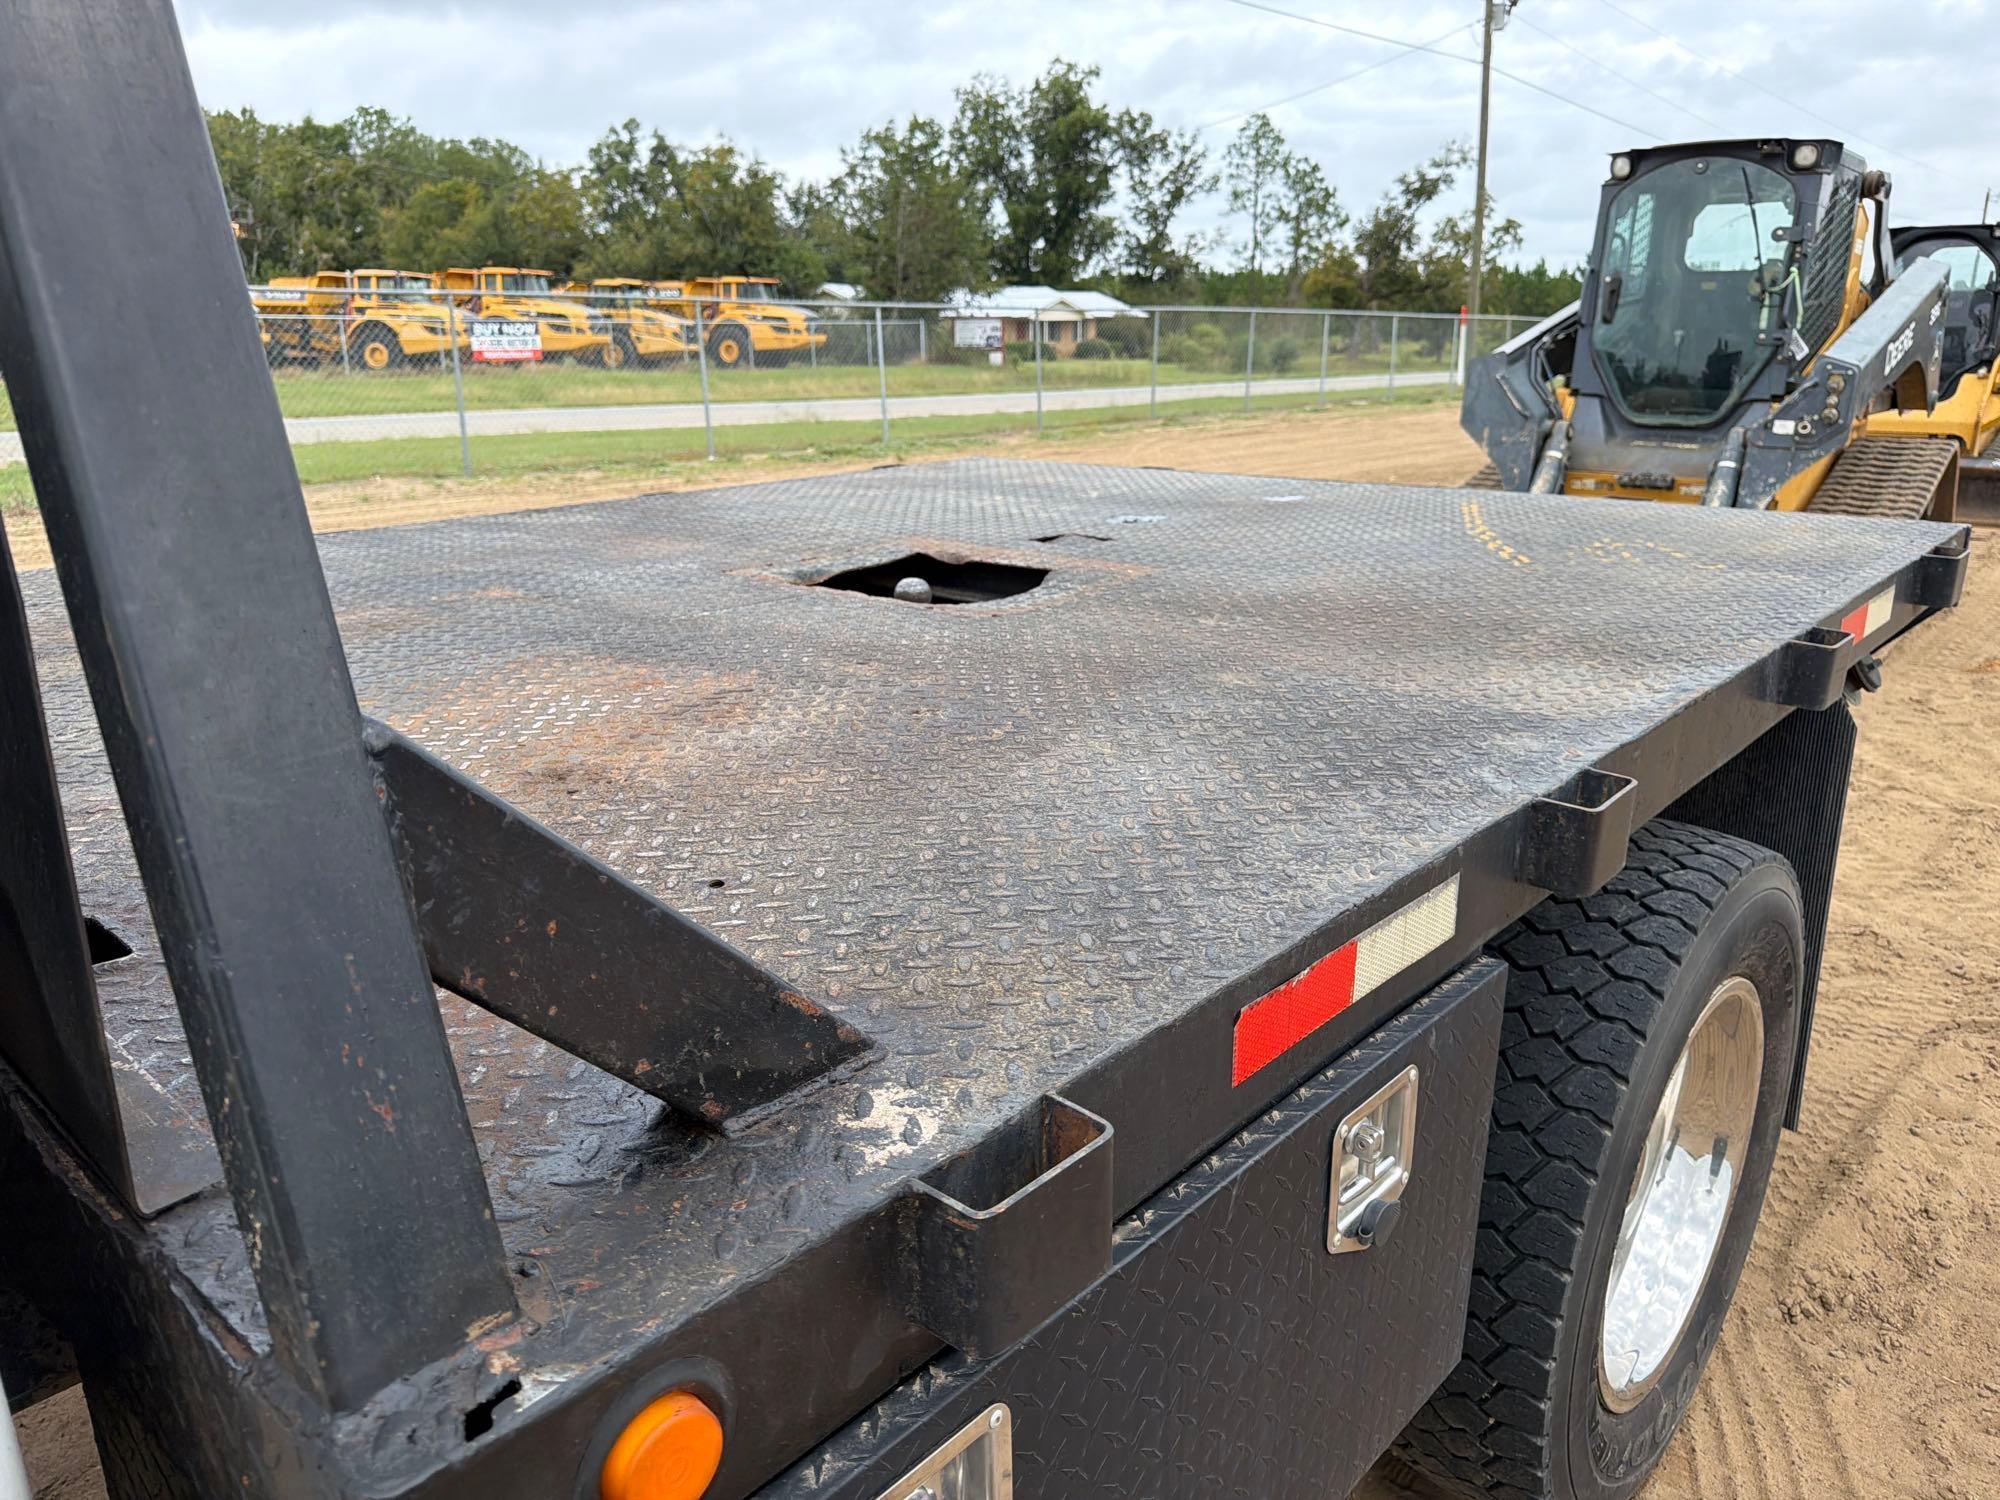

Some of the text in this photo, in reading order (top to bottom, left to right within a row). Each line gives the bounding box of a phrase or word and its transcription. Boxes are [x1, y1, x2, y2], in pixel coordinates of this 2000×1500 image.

[473, 322, 536, 337] BUY NOW
[1883, 320, 1916, 377] DEERE
